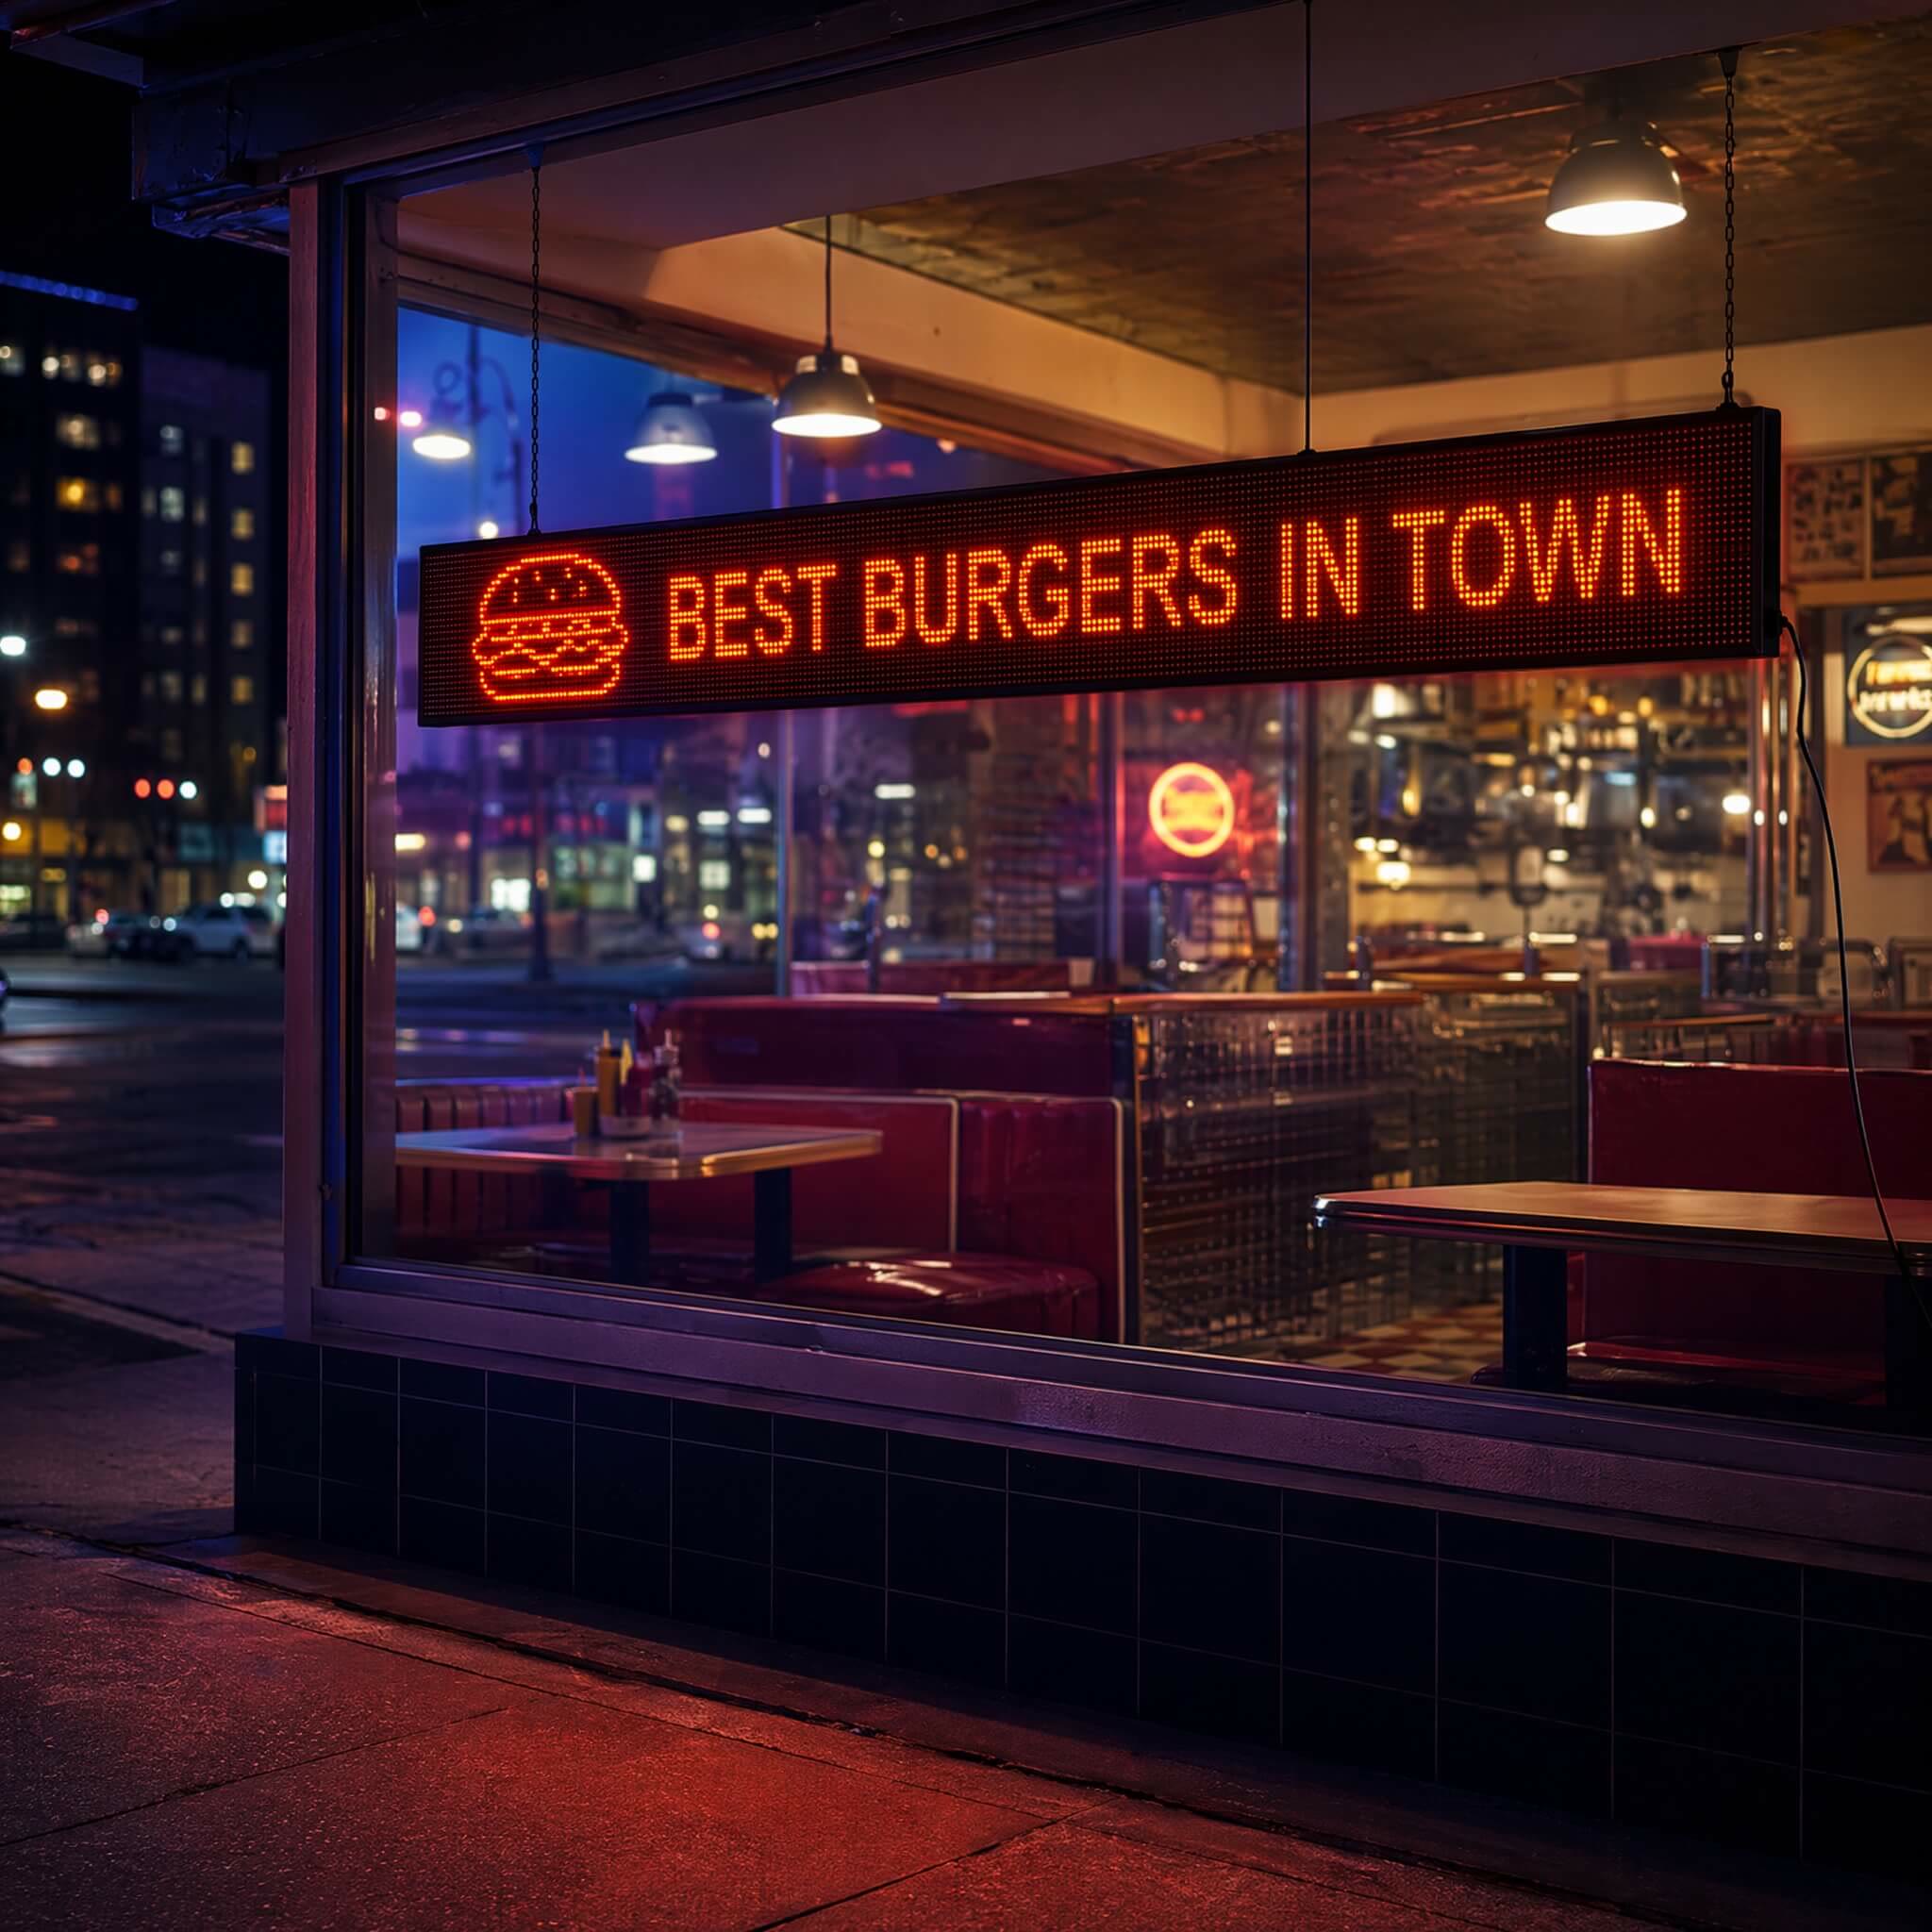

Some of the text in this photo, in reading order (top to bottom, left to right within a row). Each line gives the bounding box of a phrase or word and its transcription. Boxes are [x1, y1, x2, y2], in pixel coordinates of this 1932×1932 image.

[668, 488, 1682, 662] BEST BURGERS IN TOWN
